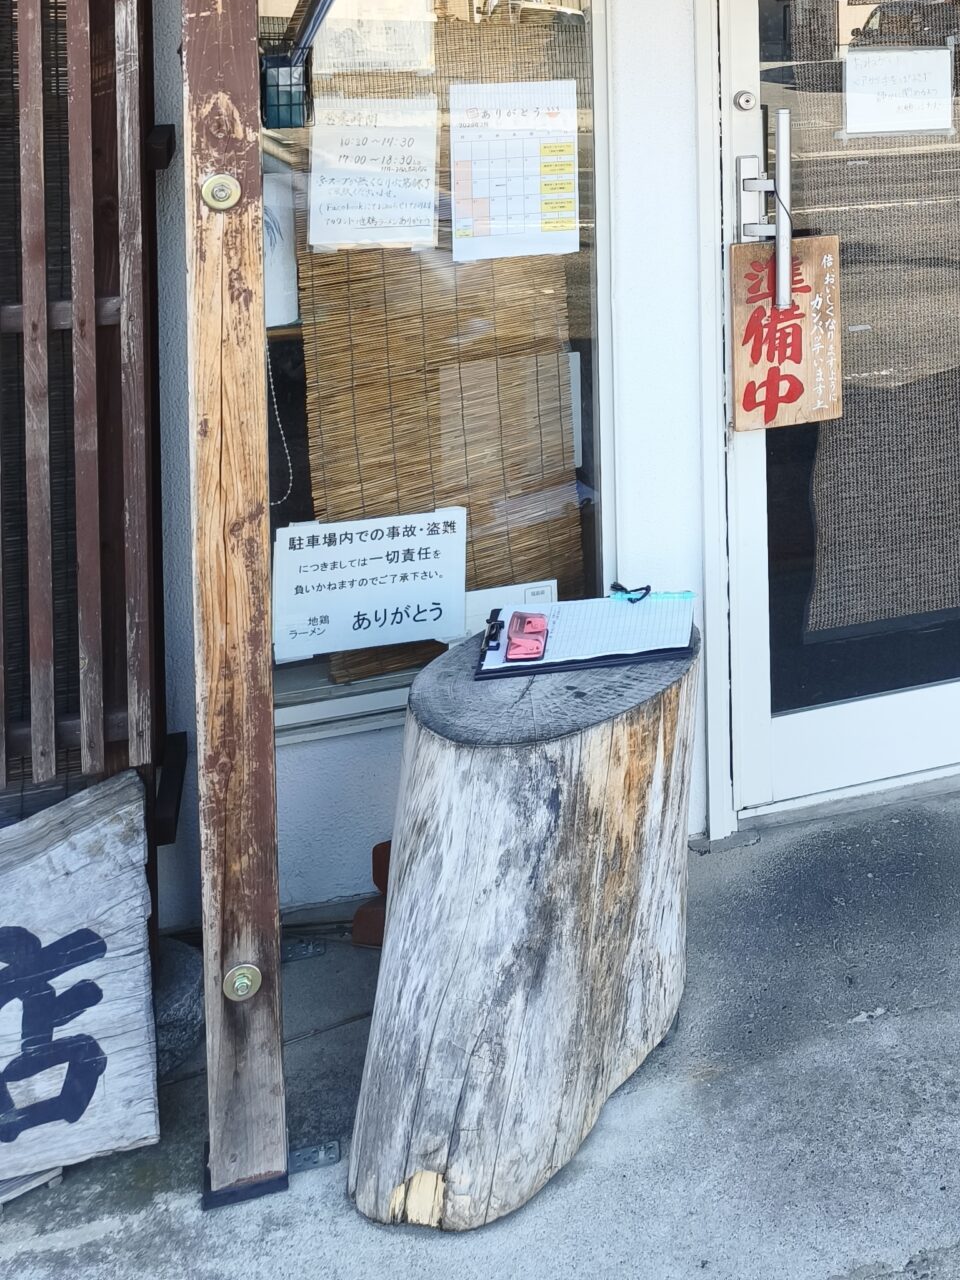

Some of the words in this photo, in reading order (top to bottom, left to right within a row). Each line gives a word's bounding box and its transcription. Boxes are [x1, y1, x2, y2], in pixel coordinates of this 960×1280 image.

[481, 106, 541, 119] ありがとう
[741, 254, 812, 425] 準備中
[288, 519, 457, 552] 駐車場内での事故・盗難
[298, 546, 442, 574] につきましては一切責任を
[294, 570, 444, 596] 負いかねますのでご了承下さい。
[307, 614, 330, 627] 地鶏
[352, 601, 444, 632] ありがとう
[288, 627, 327, 640] ラーメン
